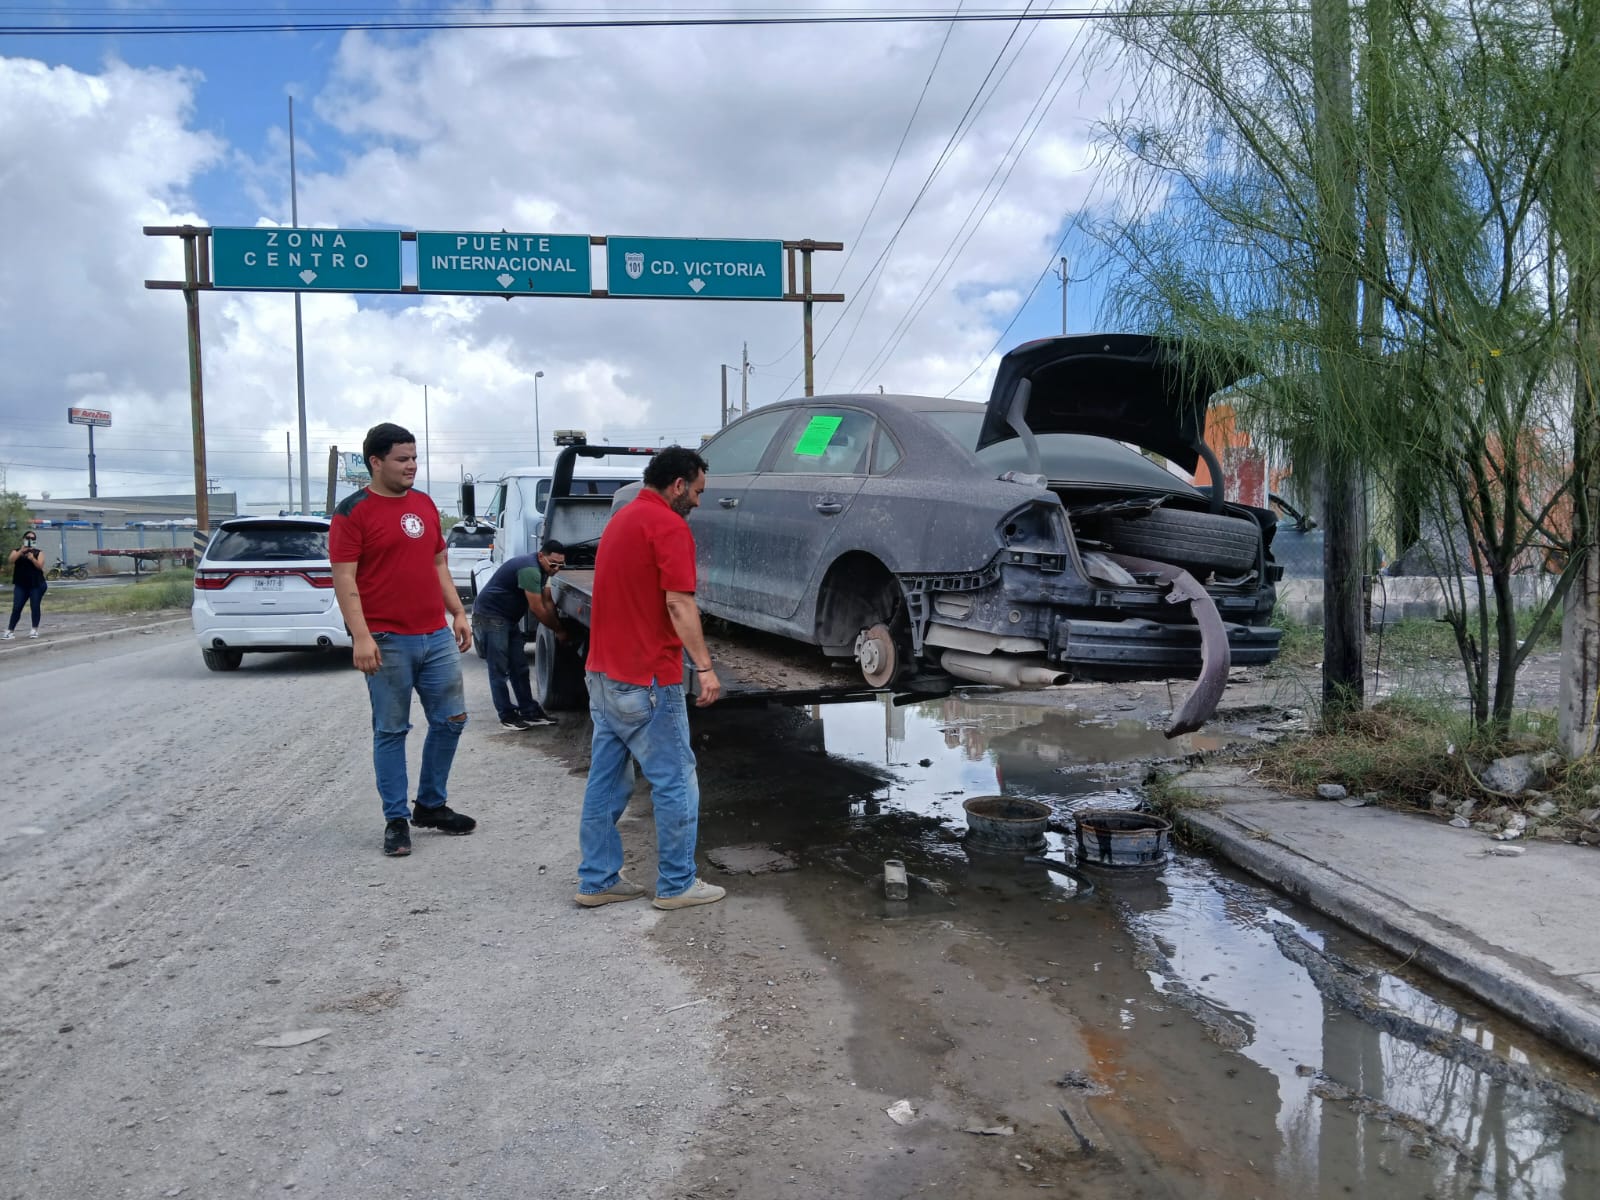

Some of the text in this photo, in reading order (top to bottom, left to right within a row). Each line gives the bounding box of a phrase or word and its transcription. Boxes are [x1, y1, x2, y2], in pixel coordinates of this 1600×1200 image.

[266, 232, 346, 248] ZONA
[456, 236, 550, 252] PUENTE
[244, 251, 368, 268] CENTRO
[431, 255, 577, 272] INTERNACIONAL
[629, 262, 641, 273] 101
[650, 260, 766, 277] CD. VICTORIA
